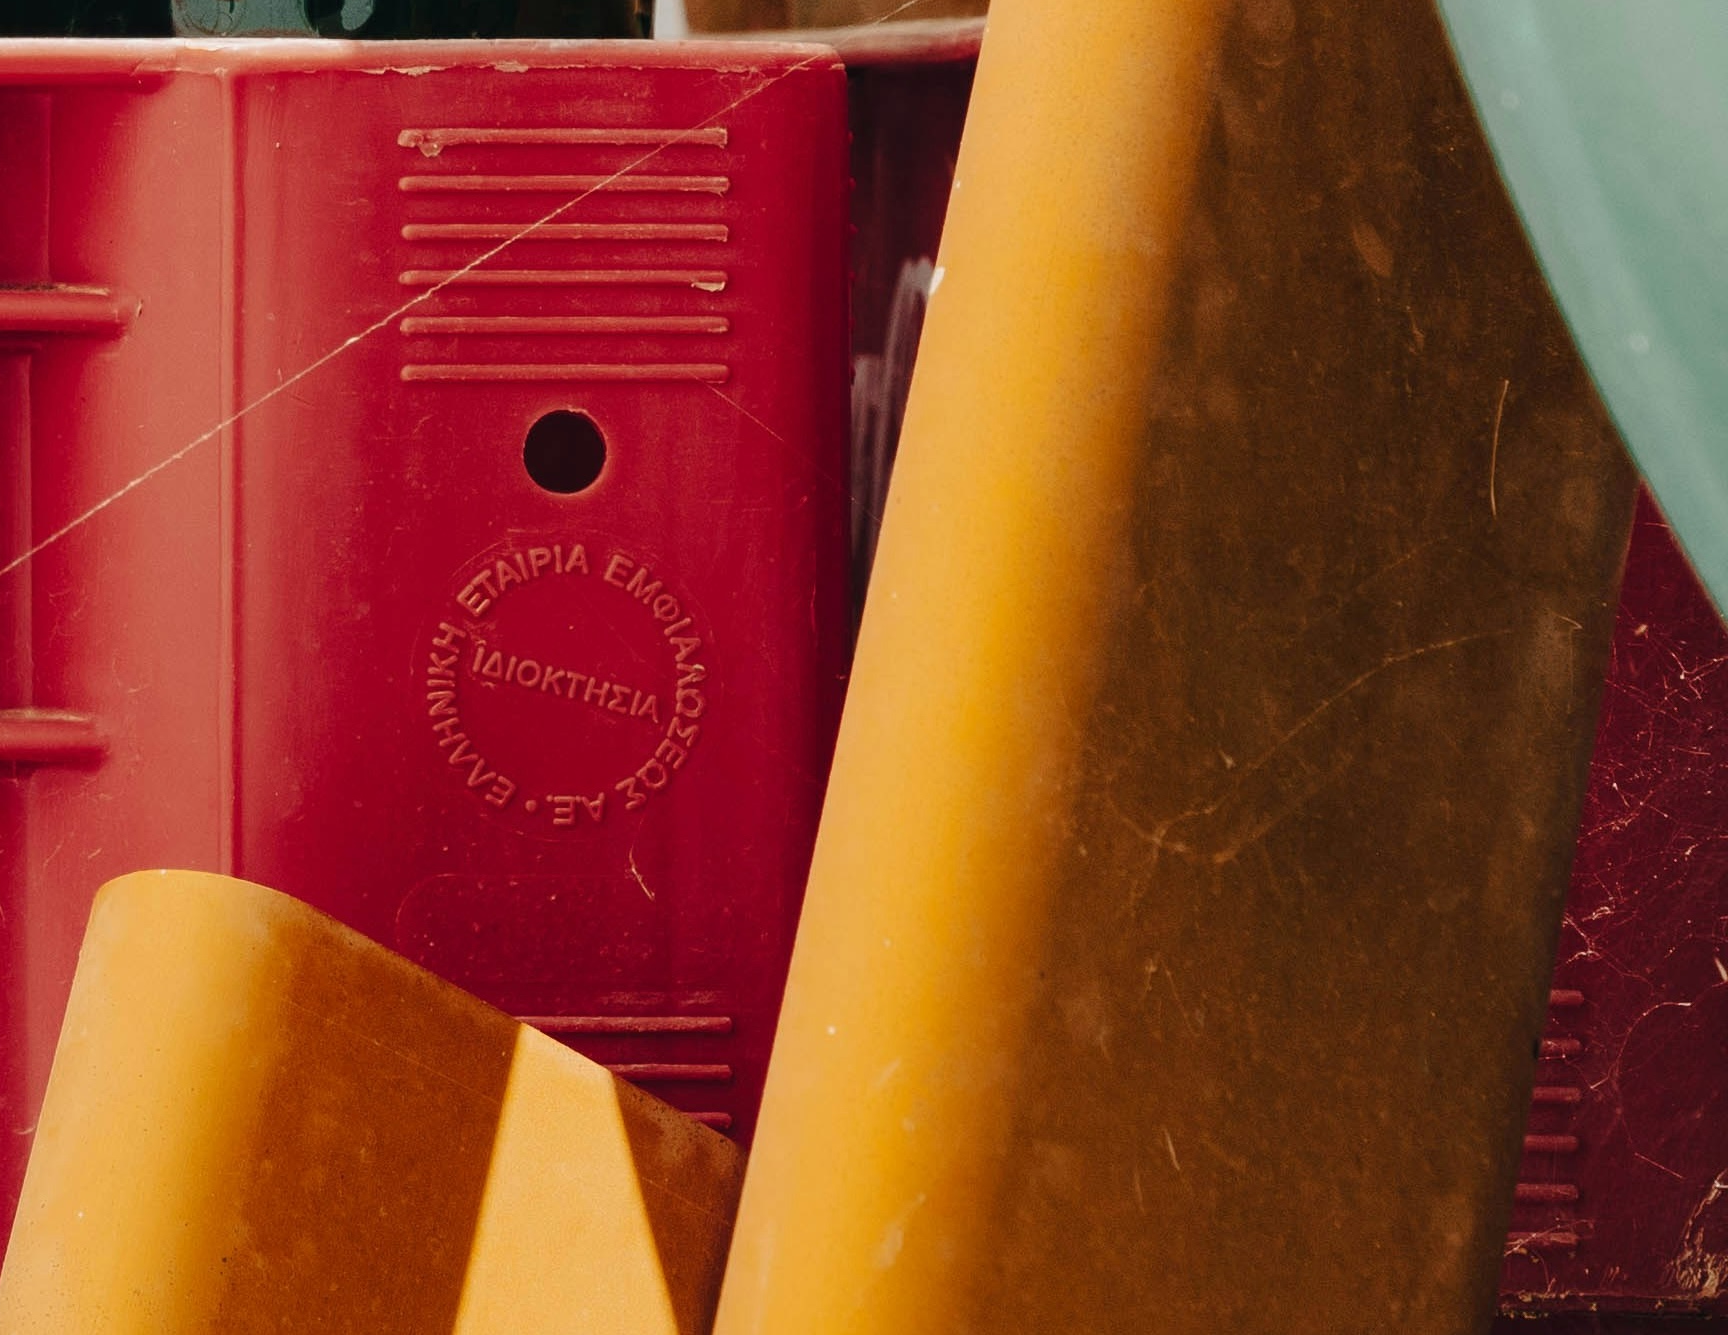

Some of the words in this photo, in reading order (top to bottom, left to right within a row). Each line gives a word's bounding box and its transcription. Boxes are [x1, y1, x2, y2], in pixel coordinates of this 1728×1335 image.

[456, 544, 589, 617] ΕΤΑΙΡΙΑ
[427, 622, 516, 808] ΕΛΛΗΝΙΚΗ
[604, 553, 705, 810] ΕΜΦΙΑΛΩΣΕΩΣ
